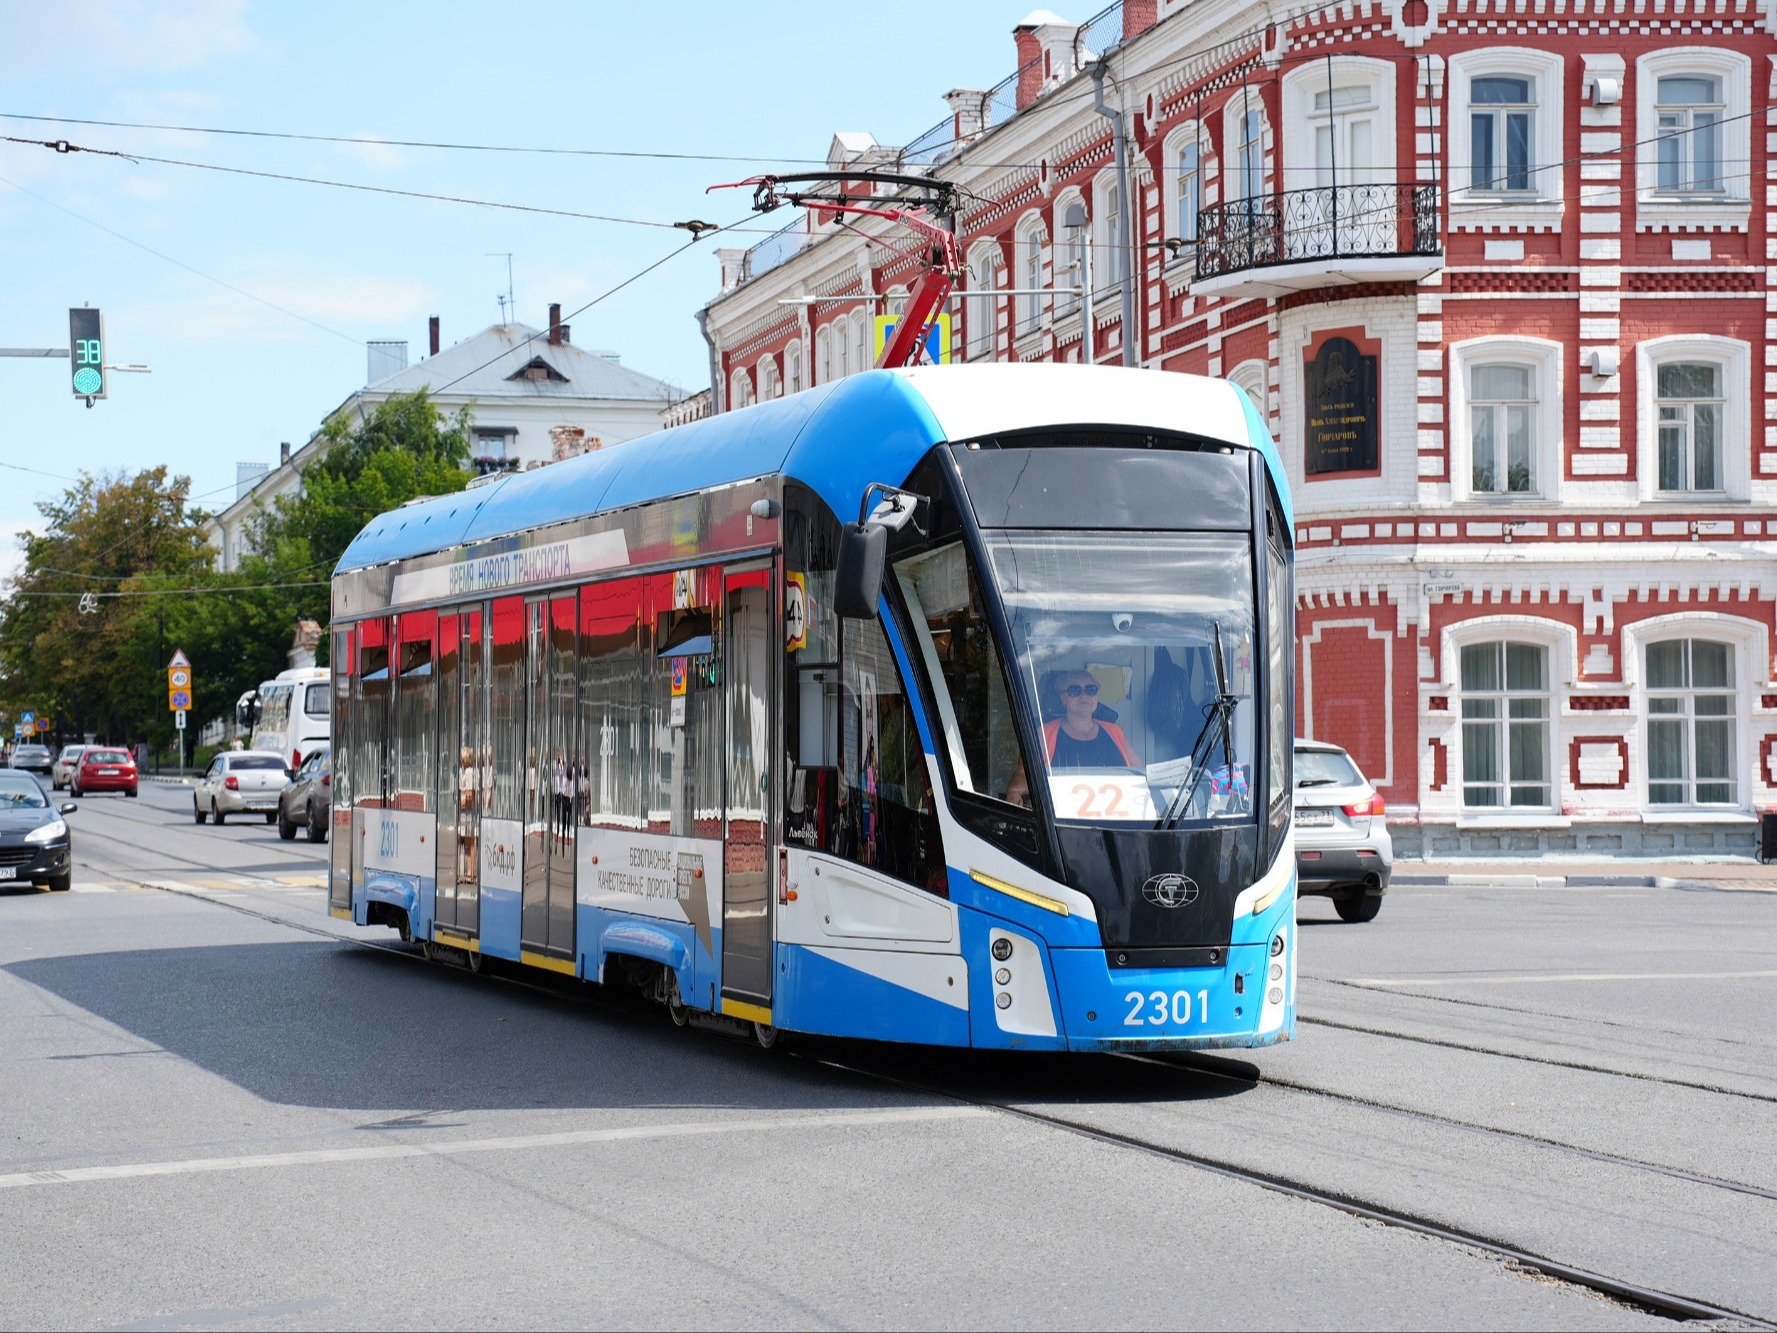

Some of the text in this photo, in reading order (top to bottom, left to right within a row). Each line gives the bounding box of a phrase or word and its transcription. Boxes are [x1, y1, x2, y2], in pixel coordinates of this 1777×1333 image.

[76, 339, 101, 364] 38
[449, 543, 571, 595] ВРЕМЯ НОВОГО ТРАНСПОРТА
[174, 675, 186, 683] 40
[1071, 783, 1129, 817] 22
[380, 821, 399, 858] 2301
[789, 826, 818, 839] Львёнок
[629, 847, 671, 871] БЕЗОПАСНЫЕ
[598, 869, 643, 897] КАЧЕСТВЕННЫЕ
[646, 876, 671, 901] ДОРОГИ
[1123, 989, 1208, 1026] 2301
